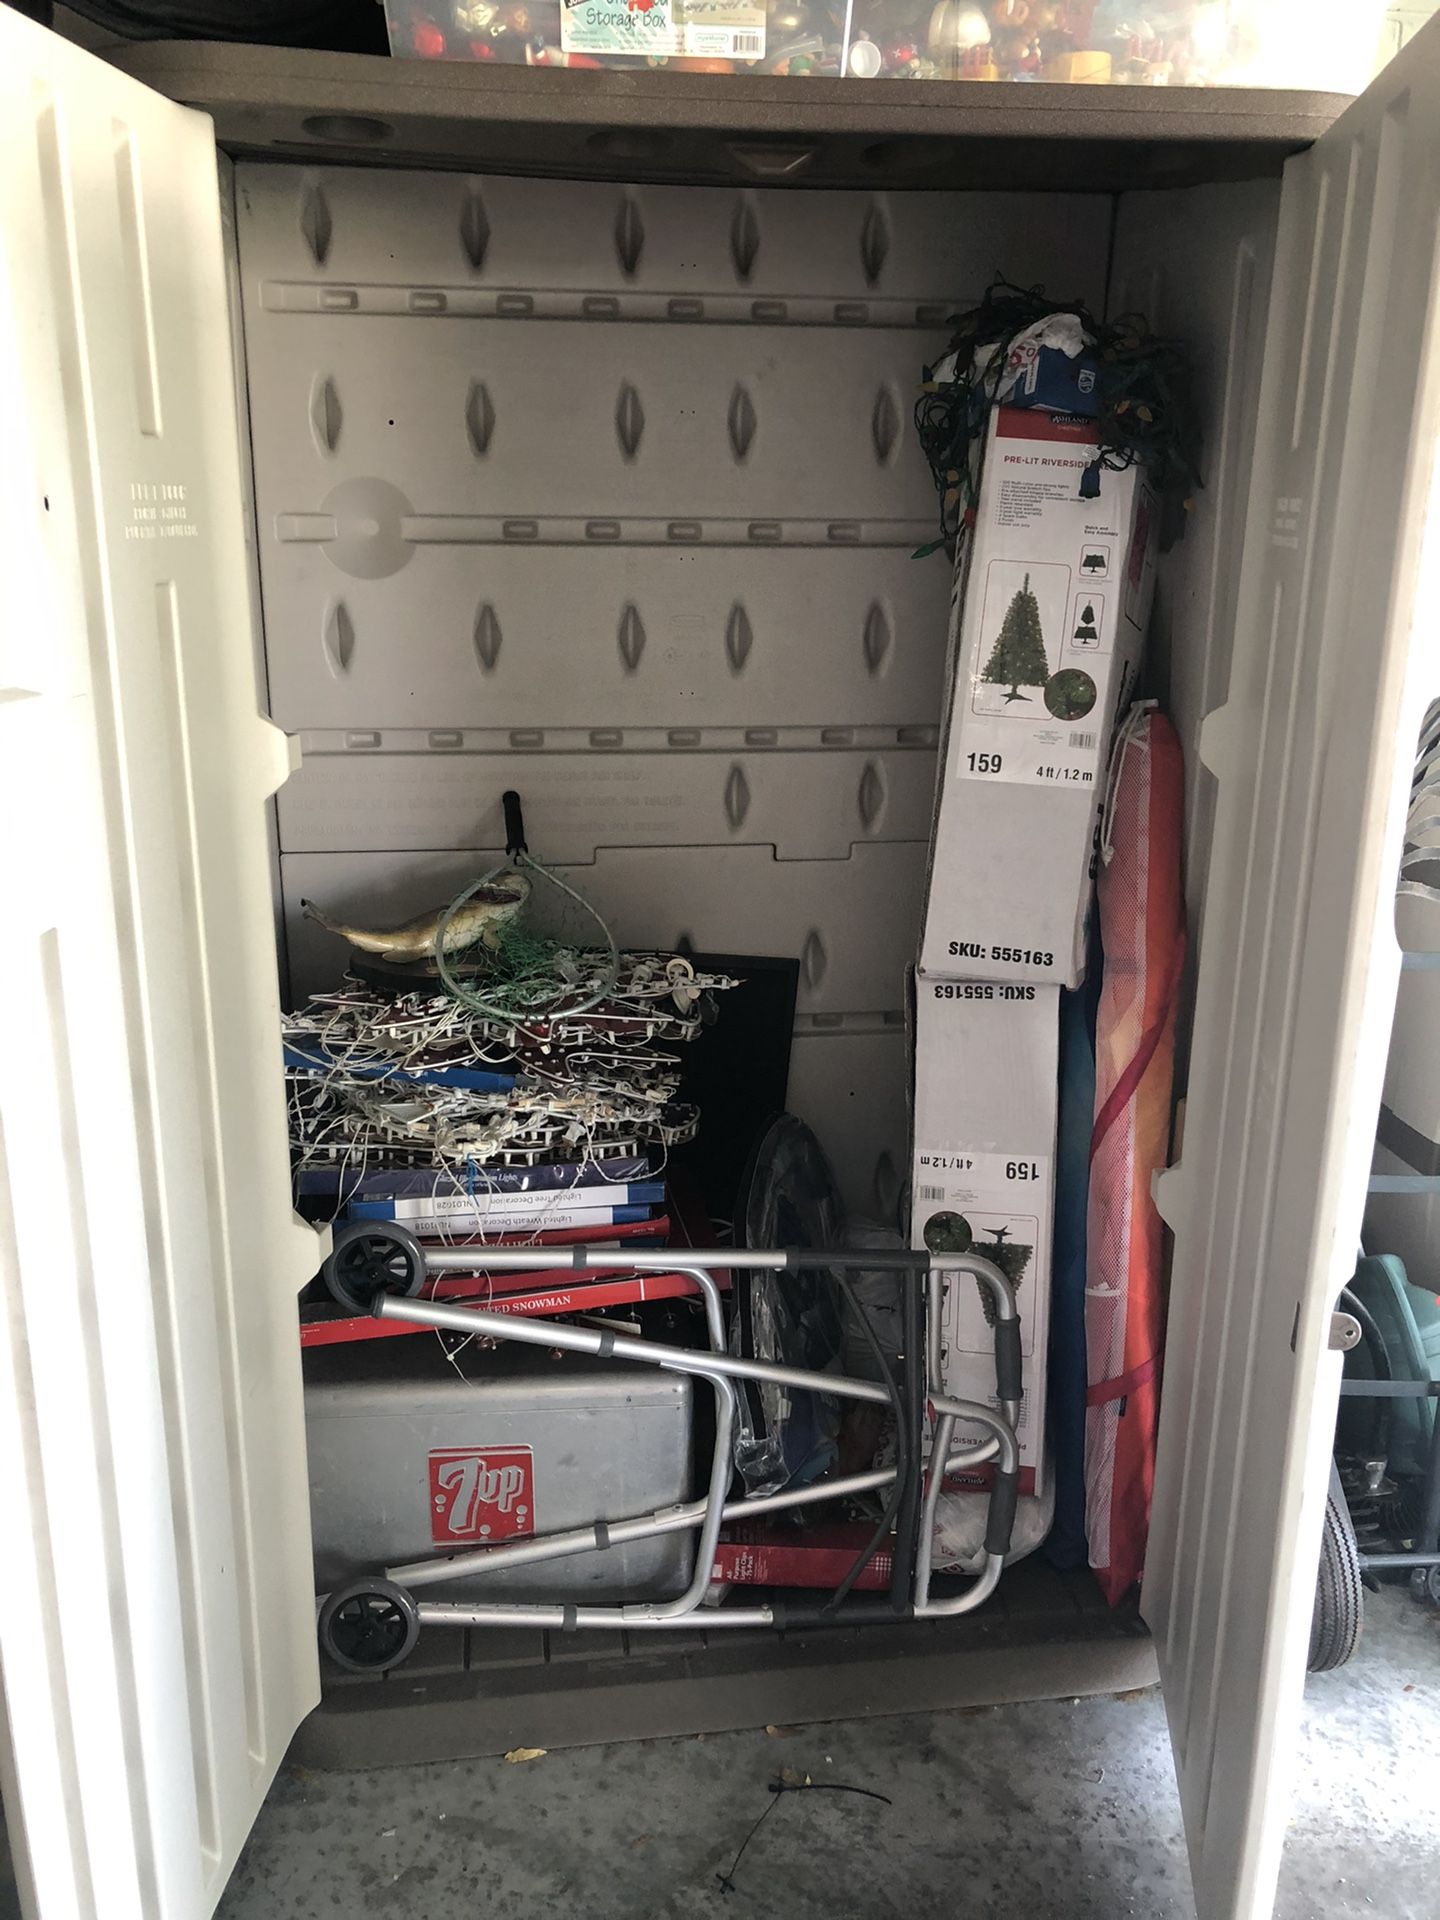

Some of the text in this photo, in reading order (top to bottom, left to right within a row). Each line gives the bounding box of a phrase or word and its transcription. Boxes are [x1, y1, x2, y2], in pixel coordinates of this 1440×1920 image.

[586, 7, 666, 31] Storage Box
[1004, 455, 1040, 466] PRE-LIT
[1041, 457, 1090, 470] RIVERSIDE
[967, 752, 1003, 774] 159
[1036, 766, 1093, 781] 4 ft / 1.2 m
[949, 941, 1054, 967] SKU: 555163
[934, 984, 1036, 1001] SKU: 555163
[920, 1156, 931, 1165] m
[932, 1156, 948, 1169] 1.2
[956, 1158, 964, 1170] ft
[966, 1159, 974, 1170] 4
[1005, 1161, 1040, 1181] 159
[535, 1195, 553, 1203] Tree
[513, 1216, 542, 1225] Wreath
[512, 1295, 572, 1313] SNOWMAN
